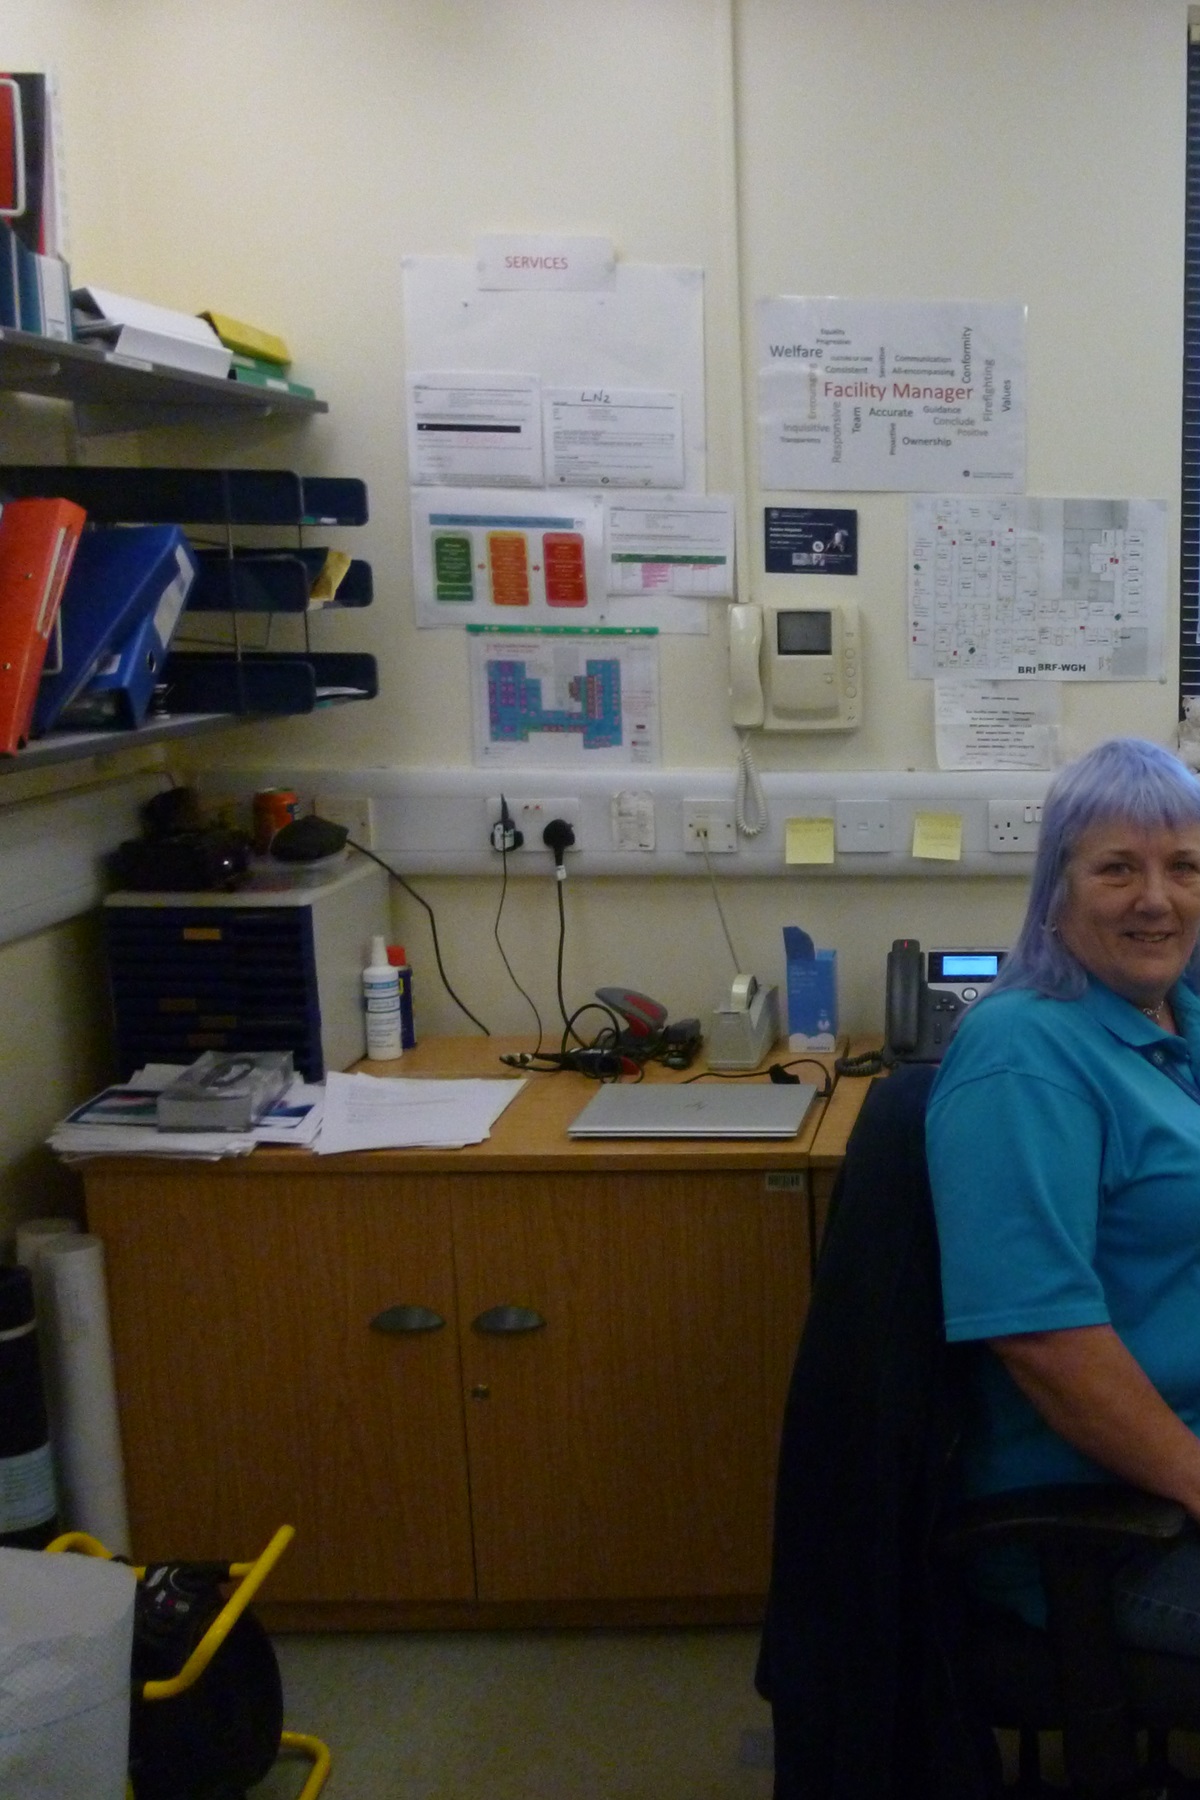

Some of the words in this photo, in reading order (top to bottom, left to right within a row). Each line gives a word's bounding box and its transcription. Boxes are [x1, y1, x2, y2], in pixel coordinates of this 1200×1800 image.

[505, 256, 568, 270] SERVICES
[770, 345, 823, 358] Welfare
[962, 326, 973, 384] Conformity
[825, 366, 868, 374] Consistent
[824, 382, 886, 402] Facility
[893, 383, 974, 403] Manager
[983, 359, 995, 421] Firefighting
[1002, 379, 1011, 413] Values
[869, 407, 913, 417] Accurate
[923, 405, 961, 414] Guidance
[852, 406, 861, 434] Team
[933, 417, 975, 426] Conclude
[783, 423, 830, 433] Inquisitive
[832, 401, 843, 463] Responsive
[902, 436, 952, 446] Ownership
[1038, 663, 1086, 672] BRF-WGH
